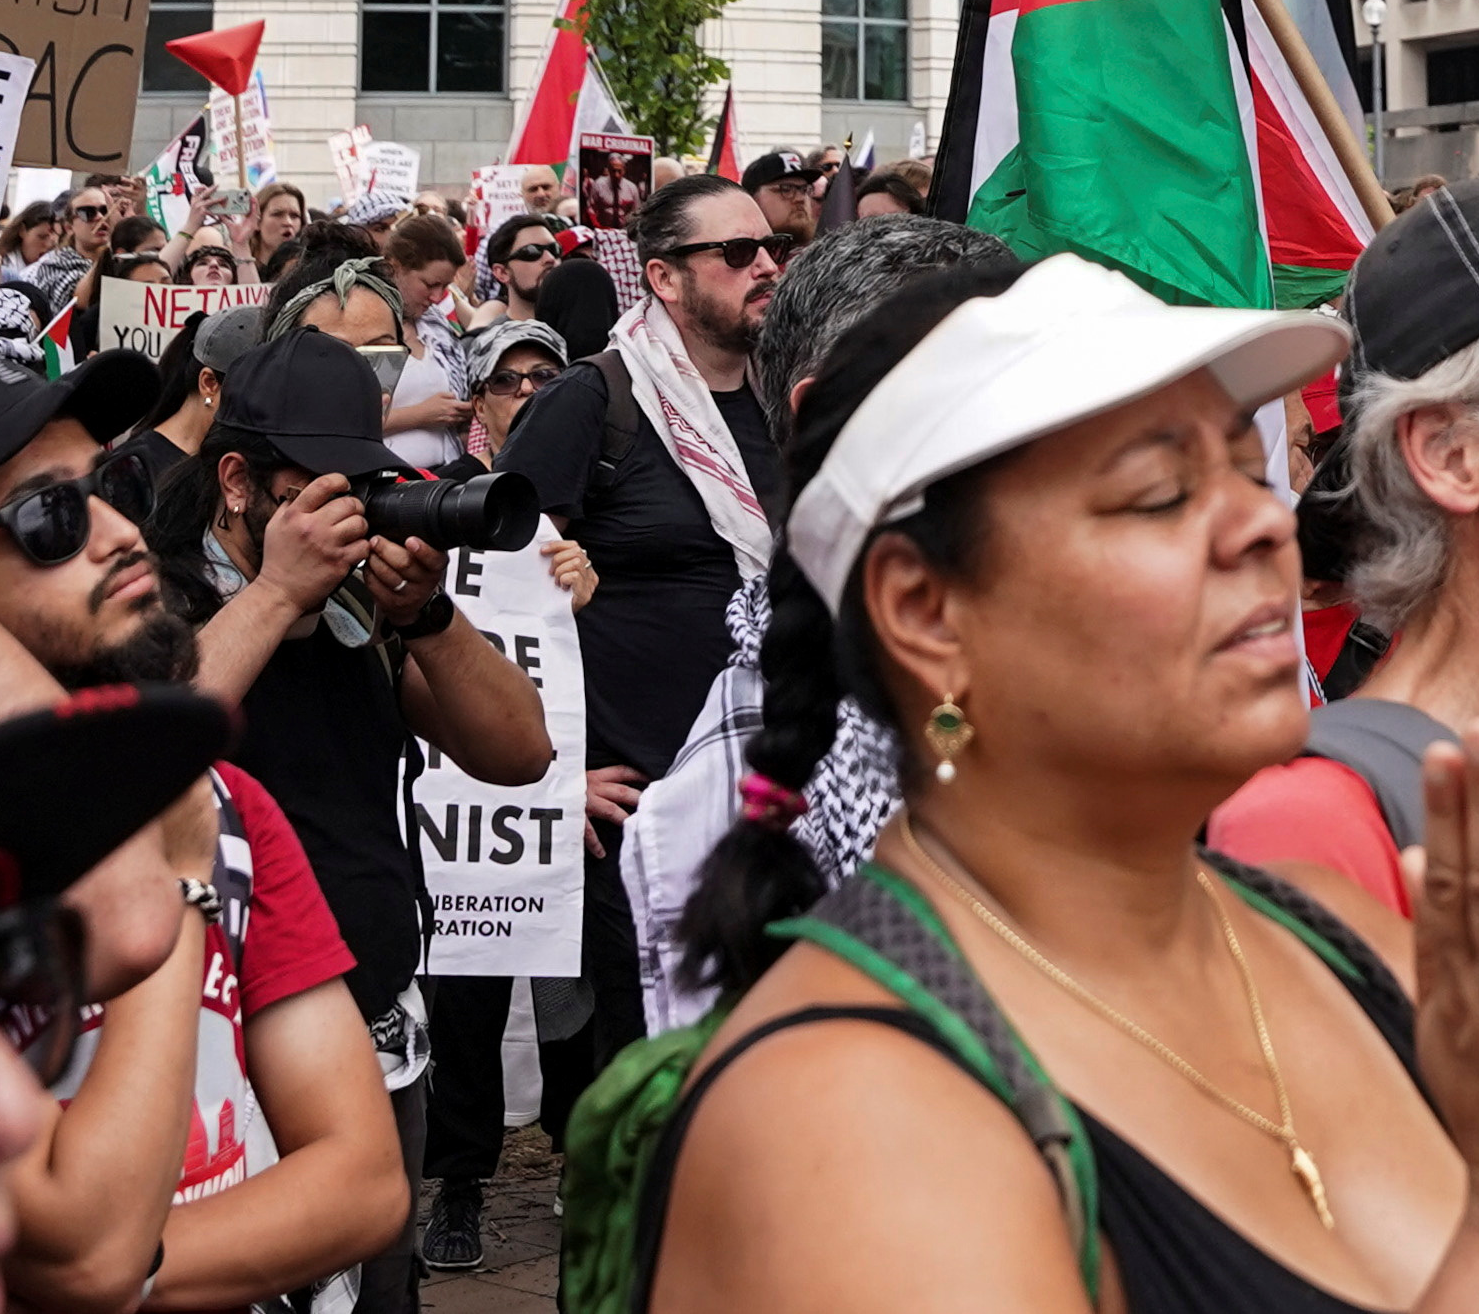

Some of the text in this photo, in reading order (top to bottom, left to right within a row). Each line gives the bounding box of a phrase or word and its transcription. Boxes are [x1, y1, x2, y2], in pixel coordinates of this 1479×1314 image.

[581, 135, 650, 153] WAR CRIMINAL
[113, 324, 162, 358] YOU
[415, 803, 564, 865] NIST
[434, 896, 544, 913] IBERATION
[433, 919, 513, 937] RATION
